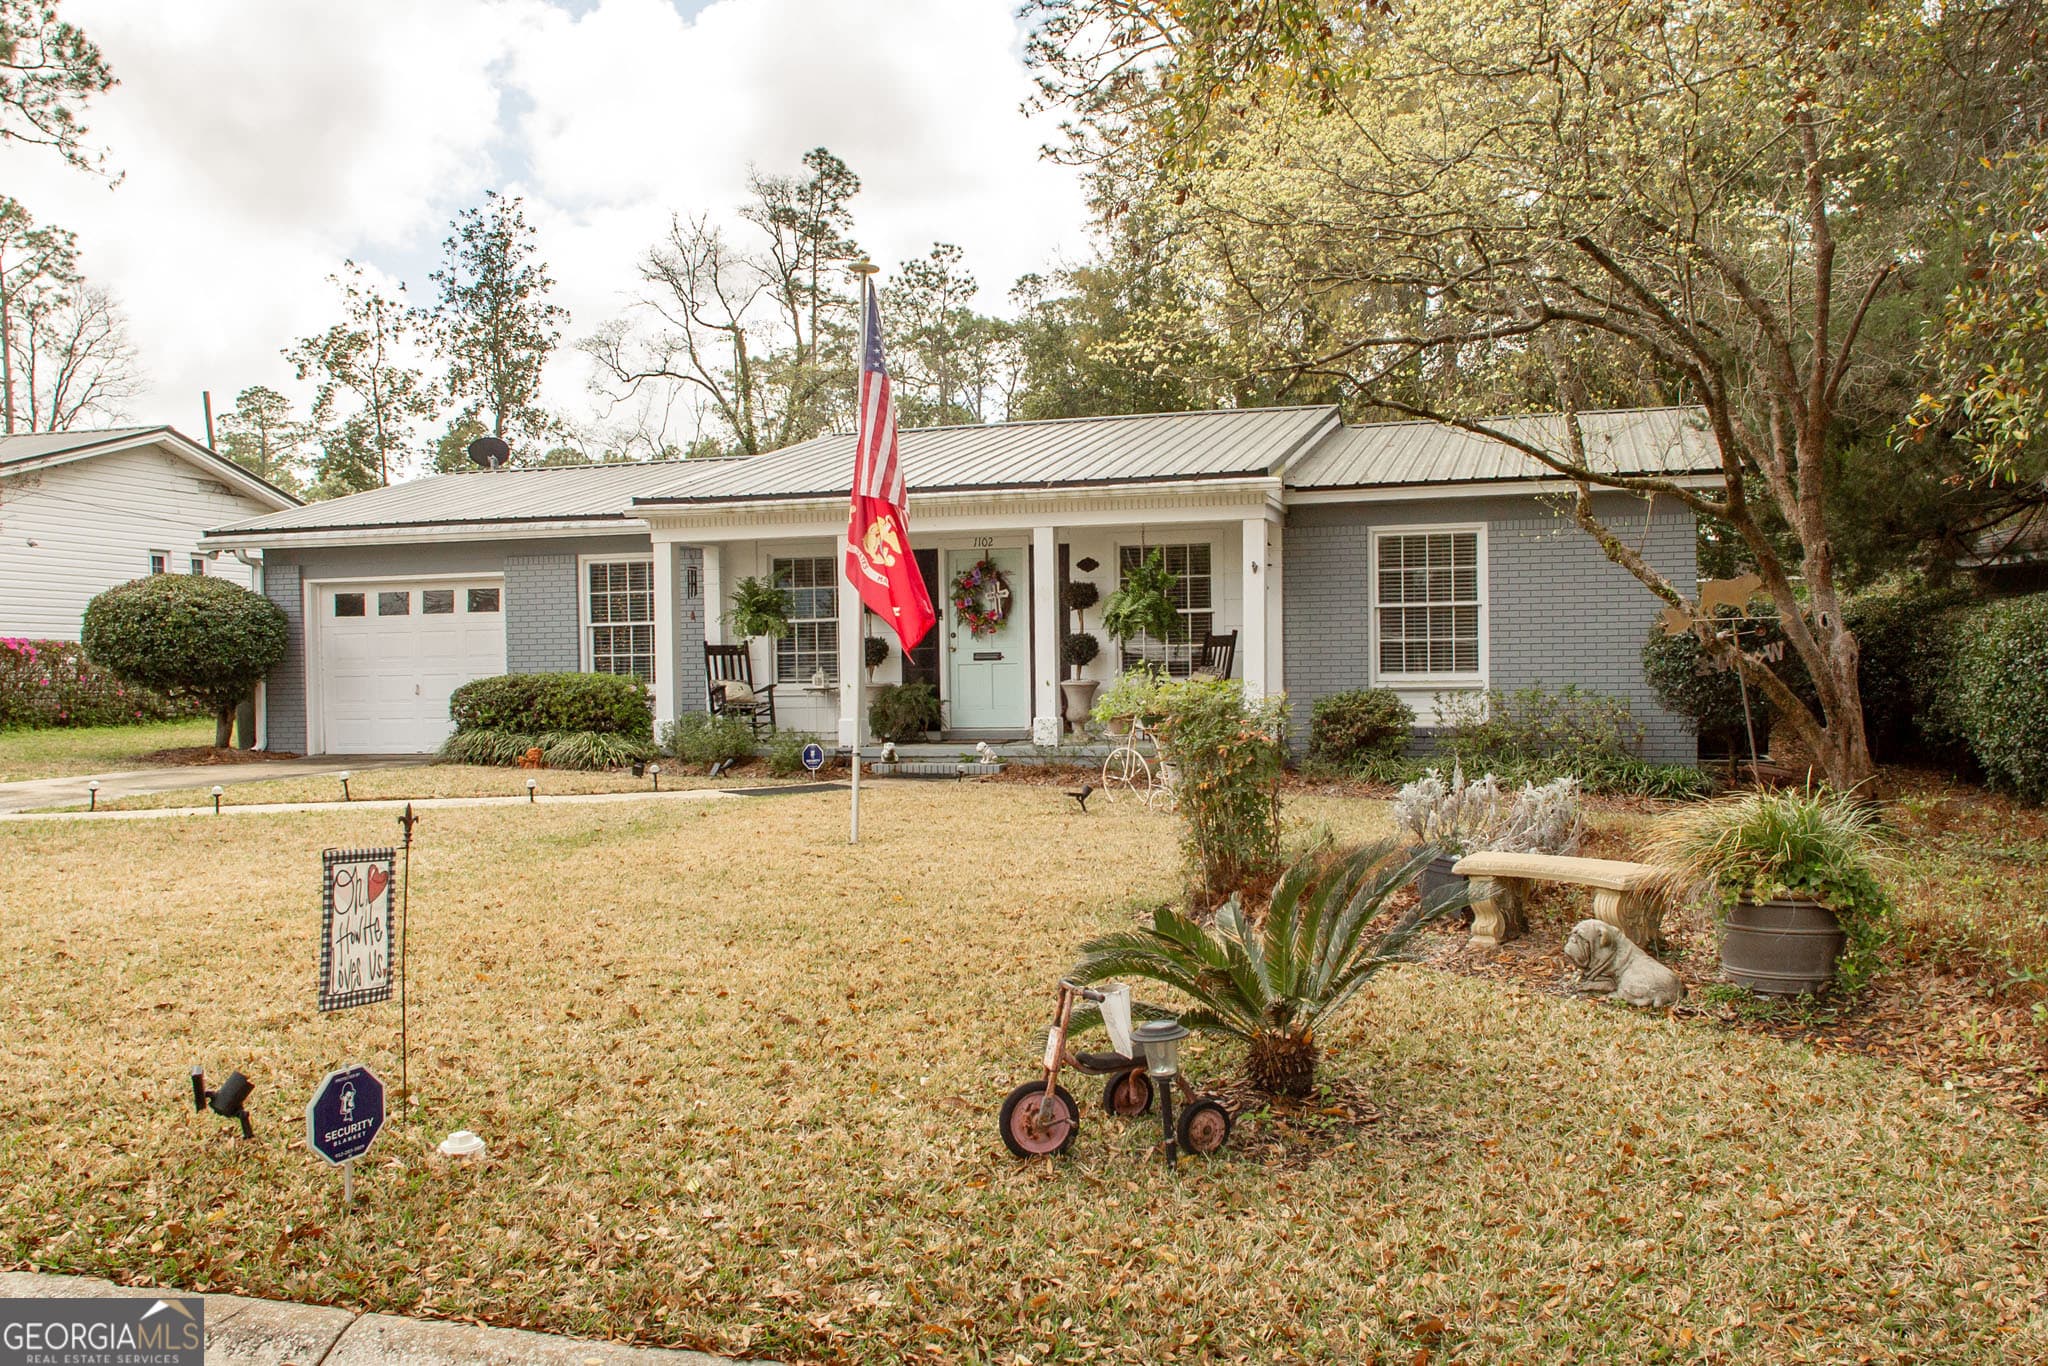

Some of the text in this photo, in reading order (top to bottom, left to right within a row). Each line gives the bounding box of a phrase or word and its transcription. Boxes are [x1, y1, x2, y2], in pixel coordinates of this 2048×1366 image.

[974, 536, 993, 547] 1102
[333, 866, 364, 915] Oh
[363, 904, 383, 946] He
[325, 1117, 374, 1142] SECURITY
[333, 1131, 367, 1147] BLANKET
